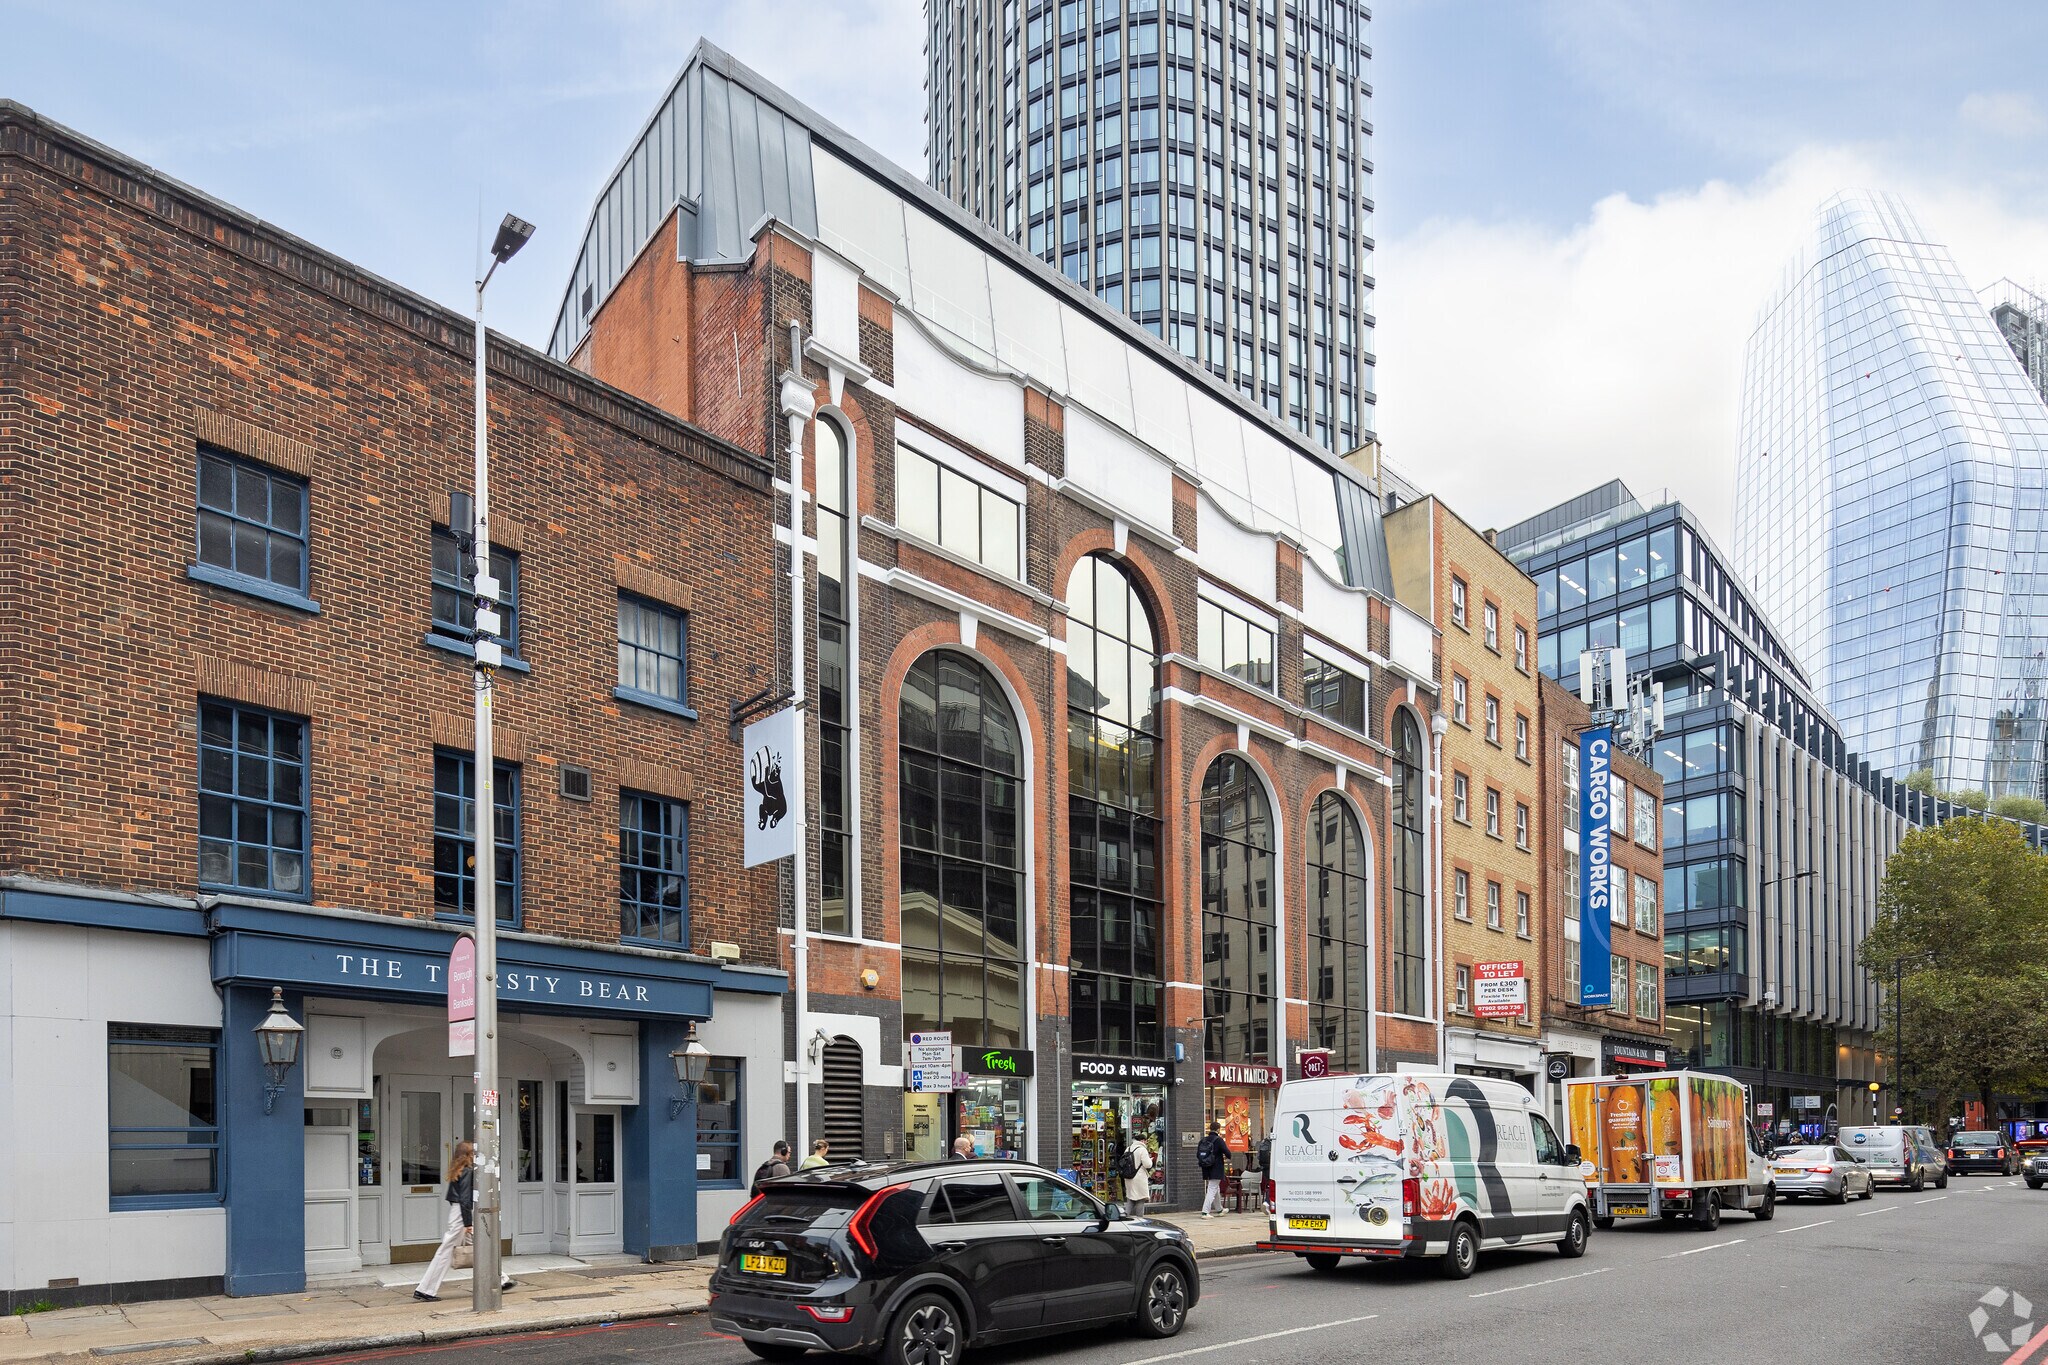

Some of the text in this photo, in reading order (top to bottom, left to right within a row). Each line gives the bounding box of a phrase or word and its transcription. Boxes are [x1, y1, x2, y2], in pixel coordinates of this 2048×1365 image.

[1590, 739, 1608, 910] CARGO WORKS
[1479, 962, 1519, 971] OFFICES
[336, 954, 650, 1002] THE TSTY BEAR
[453, 968, 473, 982] Borough
[453, 996, 474, 1010] Bankside
[1580, 1043, 1593, 1053] HOUSE
[1613, 1045, 1636, 1057] FOUNTAIN
[1640, 1049, 1648, 1058] INK
[981, 1051, 1016, 1073] Fresh
[1308, 1063, 1321, 1072] PRET
[1080, 1062, 1166, 1078] FOOD & NEWS
[1220, 1066, 1269, 1084] PRET A MANGER
[1707, 1116, 1731, 1131] Sainsbury's
[1496, 1125, 1526, 1141] REACH
[1284, 1145, 1323, 1156] REACH
[1310, 1220, 1324, 1228] EHX
